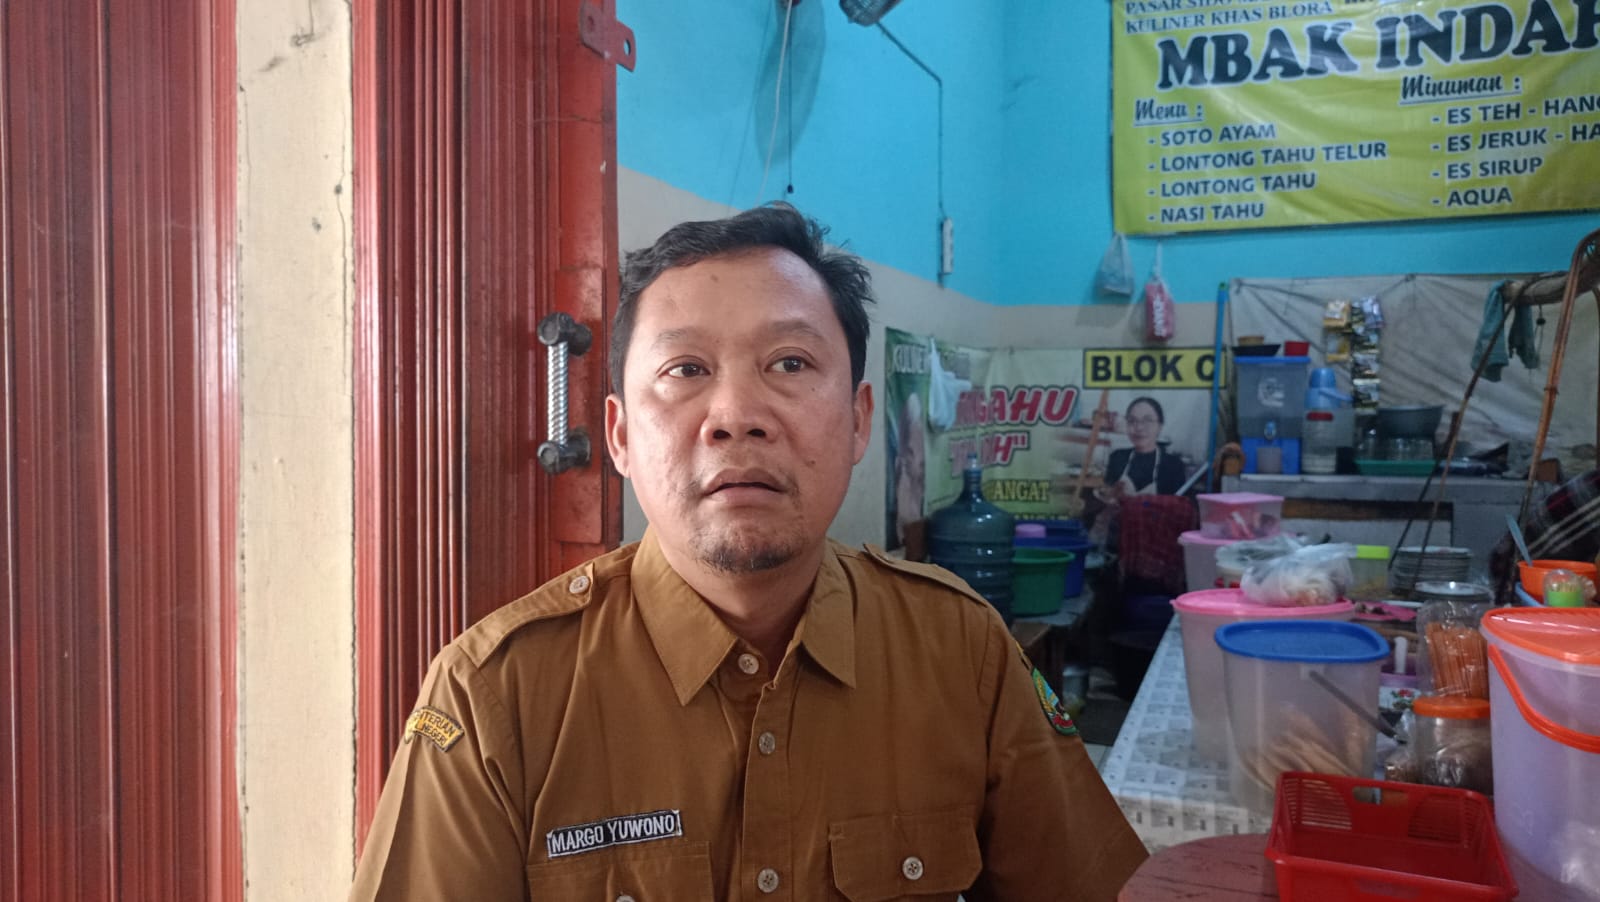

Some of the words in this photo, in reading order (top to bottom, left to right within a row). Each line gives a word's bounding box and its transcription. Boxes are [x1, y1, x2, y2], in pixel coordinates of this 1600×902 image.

[1126, 0, 1181, 14] PASAR
[1126, 14, 1205, 33] KULINER
[1211, 9, 1262, 25] KHAS
[1269, 2, 1333, 19] BLORA
[1158, 22, 1358, 89] MBAK
[1402, 75, 1503, 99] Minuman
[1135, 99, 1187, 121] Menu
[1447, 107, 1471, 124] ES
[1478, 103, 1521, 121] TEH
[1161, 128, 1212, 146] SOTO
[1218, 124, 1276, 142] AYAM
[1447, 135, 1471, 152] ES
[1478, 128, 1547, 150] JERUK
[1161, 151, 1255, 172] LONTONG
[1261, 147, 1315, 165] TAHU
[1322, 142, 1387, 161] TELUR
[1447, 163, 1471, 179] ES
[1479, 157, 1543, 177] SIRUP
[1161, 177, 1255, 198] LONTONG
[1261, 173, 1316, 191] TAHU
[1447, 187, 1513, 207] AQUA
[1161, 207, 1204, 223] NASI
[1211, 203, 1264, 219] TAHU
[1091, 354, 1183, 382] BLOK
[992, 480, 1049, 501] ANGAT
[552, 825, 604, 853] MARGO
[607, 815, 674, 842] YUWONO
